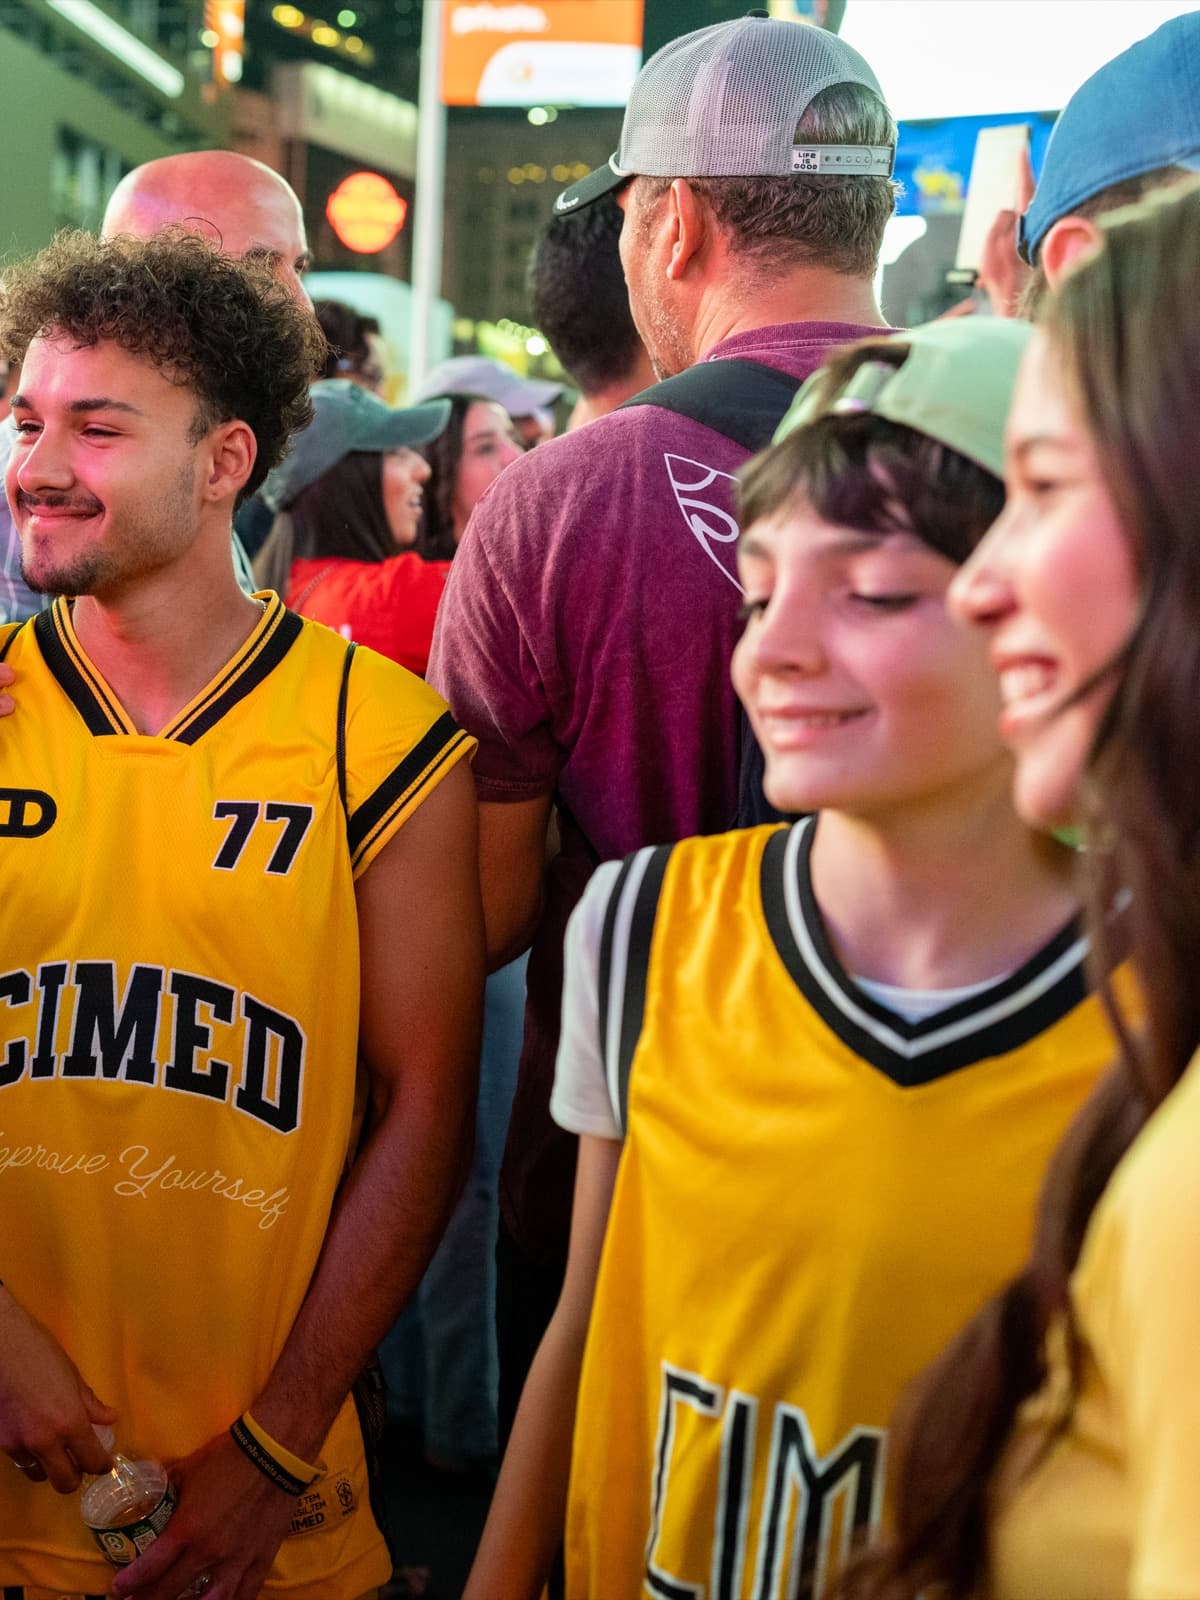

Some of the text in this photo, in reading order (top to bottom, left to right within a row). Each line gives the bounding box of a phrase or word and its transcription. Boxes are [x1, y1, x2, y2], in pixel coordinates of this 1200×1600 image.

[211, 801, 314, 876] 77
[113, 1145, 291, 1231] Yourself
[288, 1512, 325, 1533] IMED
